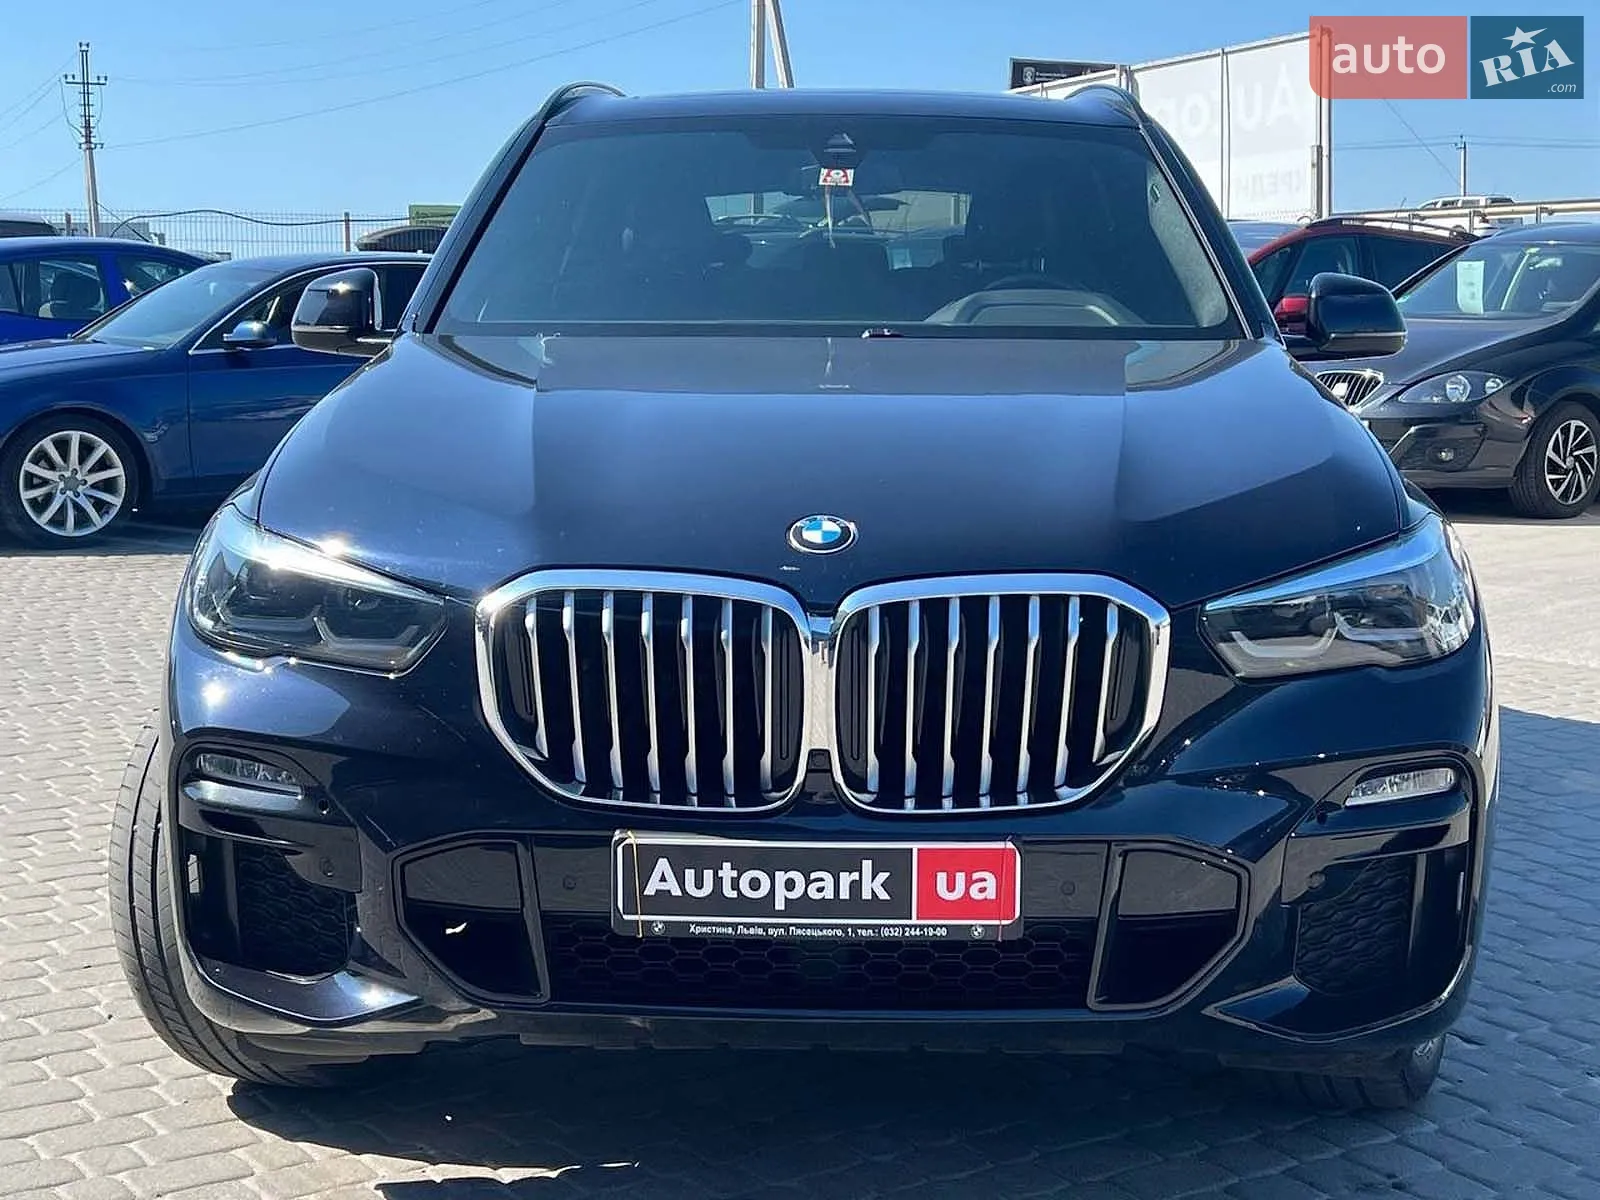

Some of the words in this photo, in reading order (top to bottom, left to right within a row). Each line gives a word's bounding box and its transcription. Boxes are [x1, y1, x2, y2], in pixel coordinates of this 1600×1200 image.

[643, 857, 891, 911] Autopark
[935, 869, 997, 901] ua
[689, 923, 735, 936] Христина,
[880, 926, 903, 938] (032)
